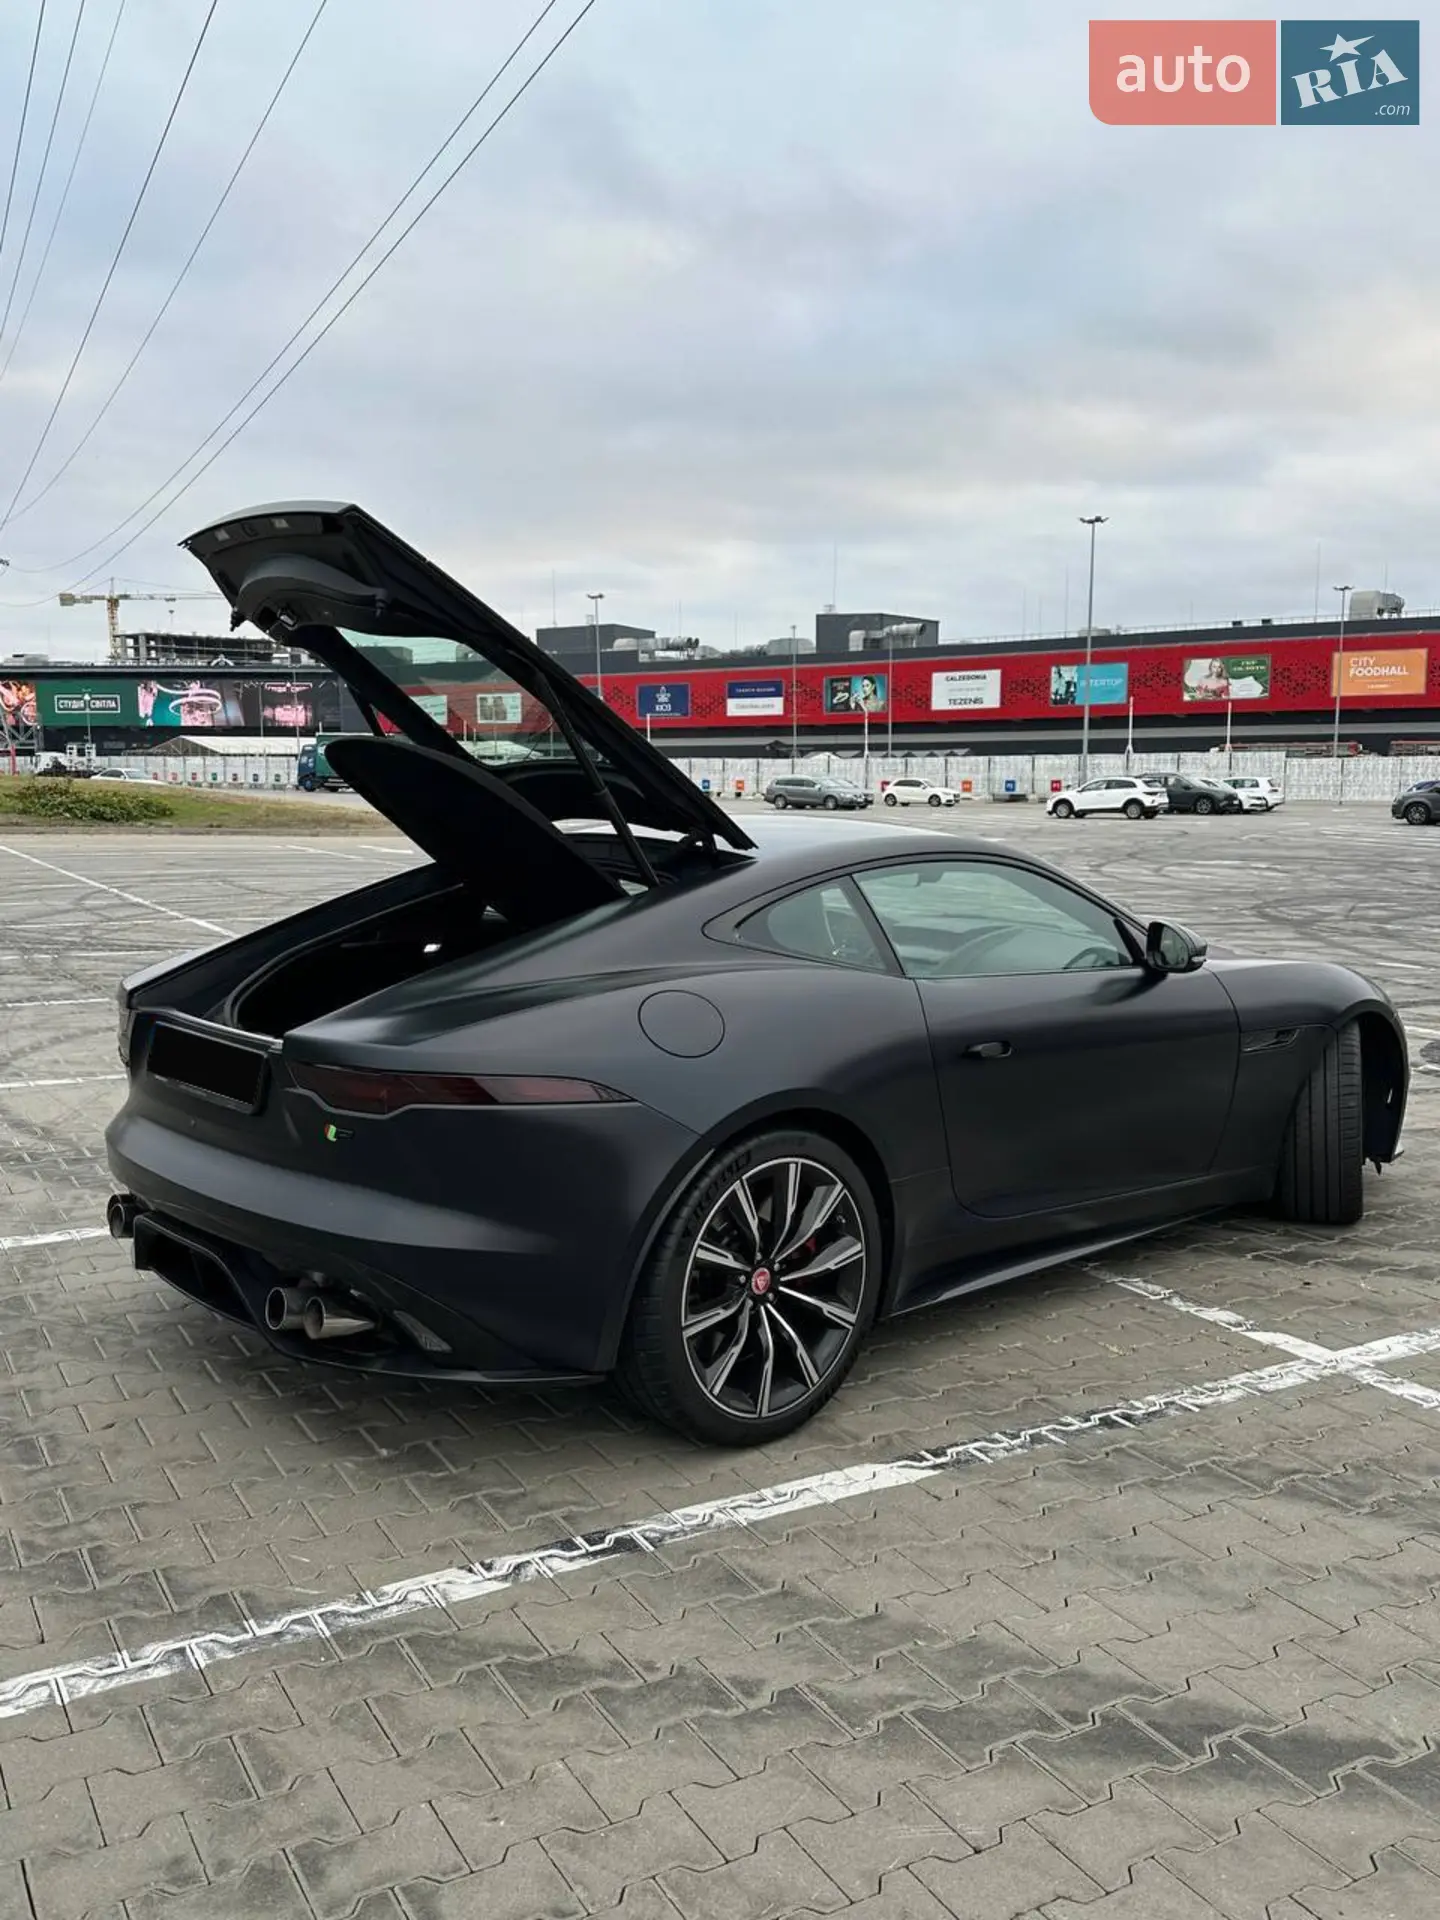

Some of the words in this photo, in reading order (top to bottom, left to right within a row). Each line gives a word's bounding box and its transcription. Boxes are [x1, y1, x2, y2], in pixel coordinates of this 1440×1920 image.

[1350, 656, 1376, 667] CITY
[1349, 665, 1409, 677] FOODHALL
[1079, 678, 1124, 687] ITERTOP
